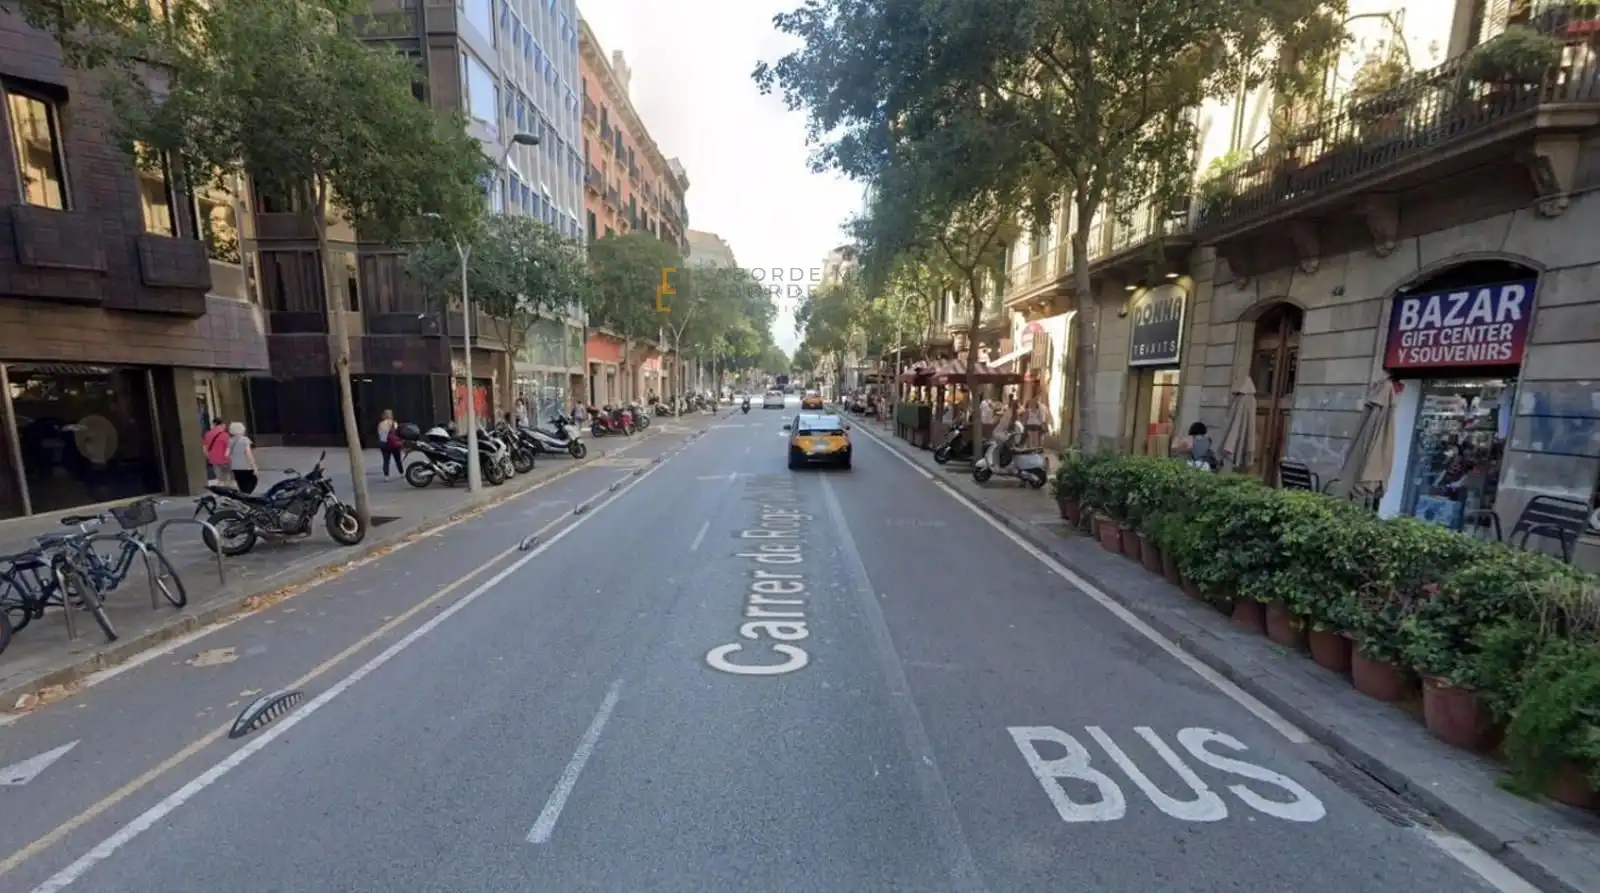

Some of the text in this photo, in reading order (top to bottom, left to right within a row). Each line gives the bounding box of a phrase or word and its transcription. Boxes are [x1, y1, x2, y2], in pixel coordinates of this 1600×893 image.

[1399, 284, 1526, 331] BAZAR
[1397, 342, 1513, 363] Y SOUVENIRS
[1402, 323, 1514, 347] GIFT CENTER
[1007, 726, 1327, 822] BUS
